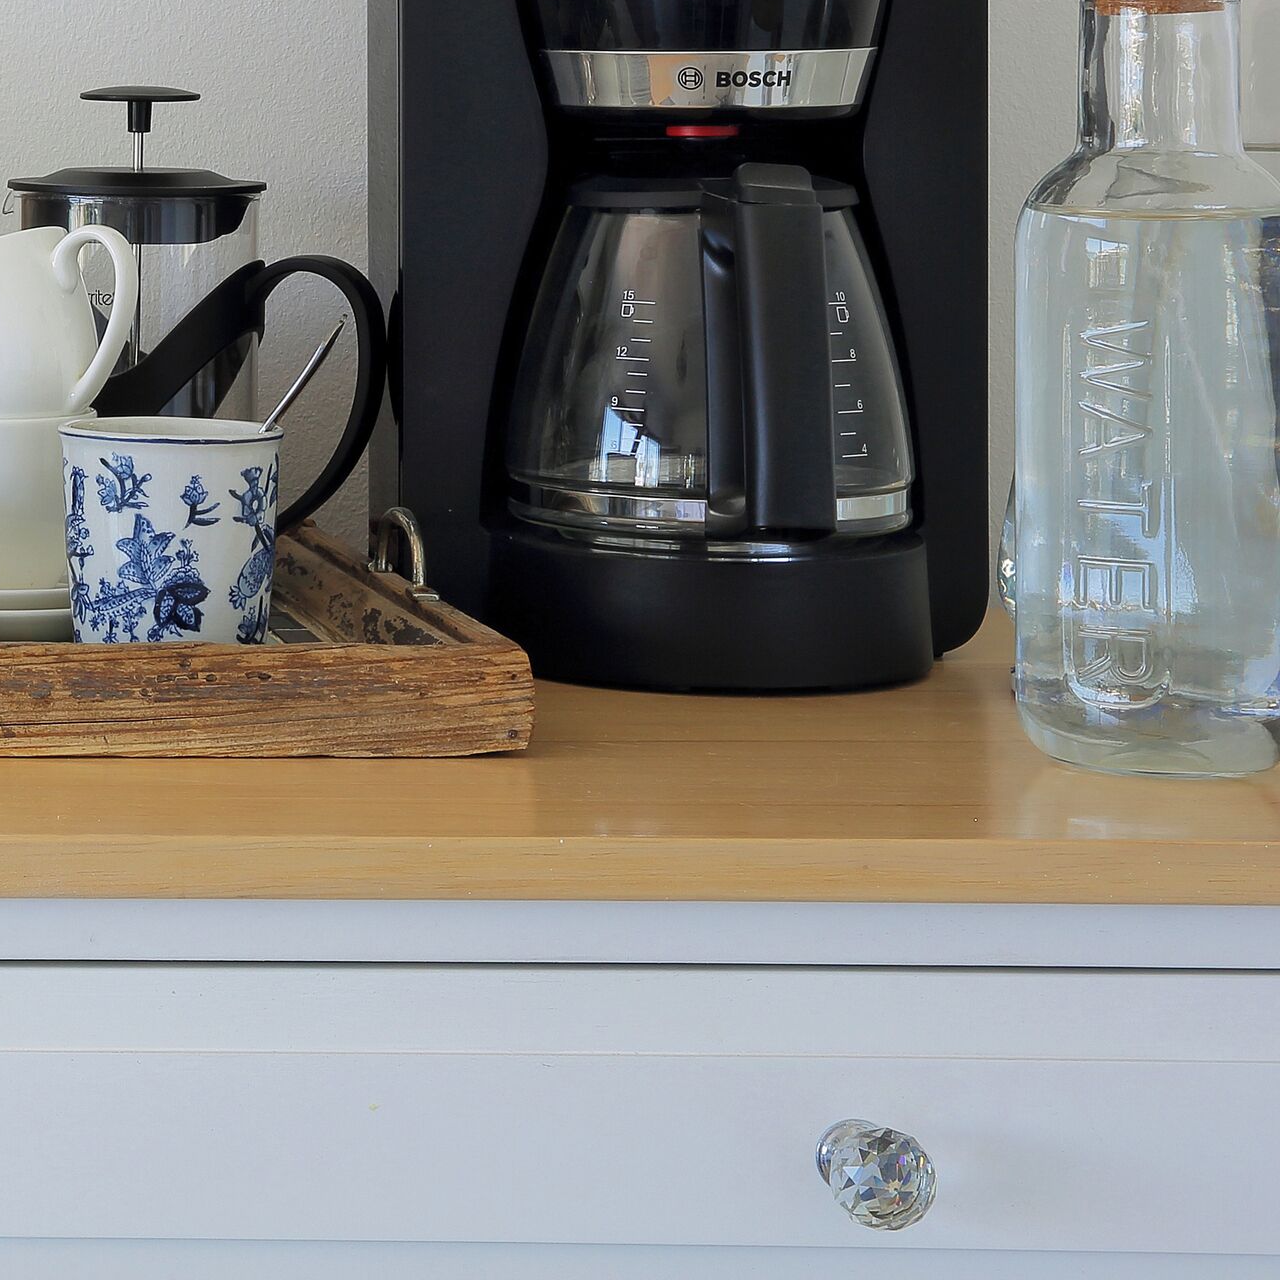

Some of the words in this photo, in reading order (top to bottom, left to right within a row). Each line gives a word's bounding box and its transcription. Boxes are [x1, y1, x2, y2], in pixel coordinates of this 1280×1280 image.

[716, 70, 792, 88] BOSCH
[622, 290, 635, 301] 15
[835, 291, 846, 302] 10
[616, 346, 628, 357] 12
[849, 348, 857, 359] 8
[611, 396, 619, 406] 9
[857, 400, 864, 410] 6
[861, 443, 868, 454] 4
[1076, 319, 1156, 686] WATER
